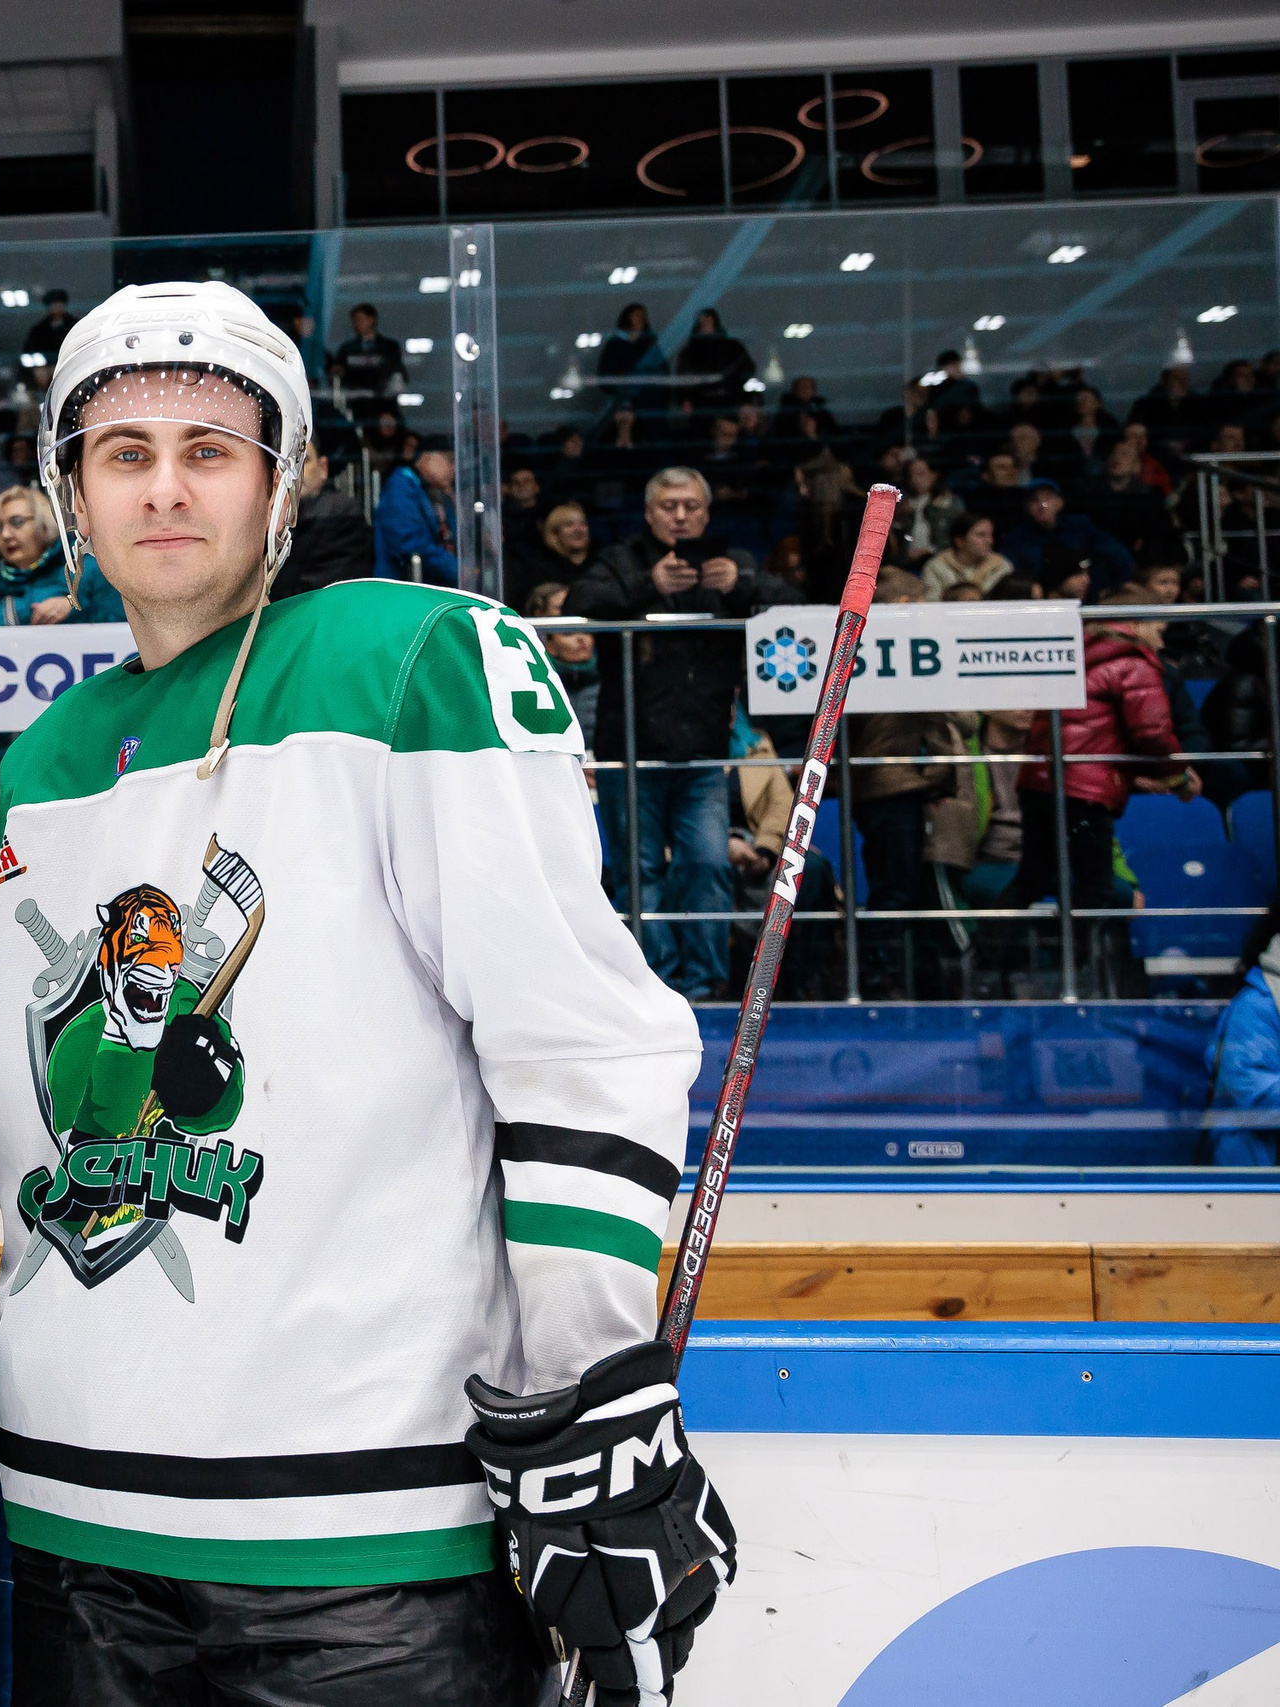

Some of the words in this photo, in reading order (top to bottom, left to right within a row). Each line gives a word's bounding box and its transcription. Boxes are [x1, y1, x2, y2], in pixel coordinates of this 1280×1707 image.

[494, 618, 574, 735] 3
[958, 649, 1075, 664] ANTHRACITE
[773, 757, 827, 906] CCM
[683, 1103, 737, 1277] JETSPEED
[482, 1409, 684, 1514] CCM
[519, 1408, 547, 1420] CUFF
